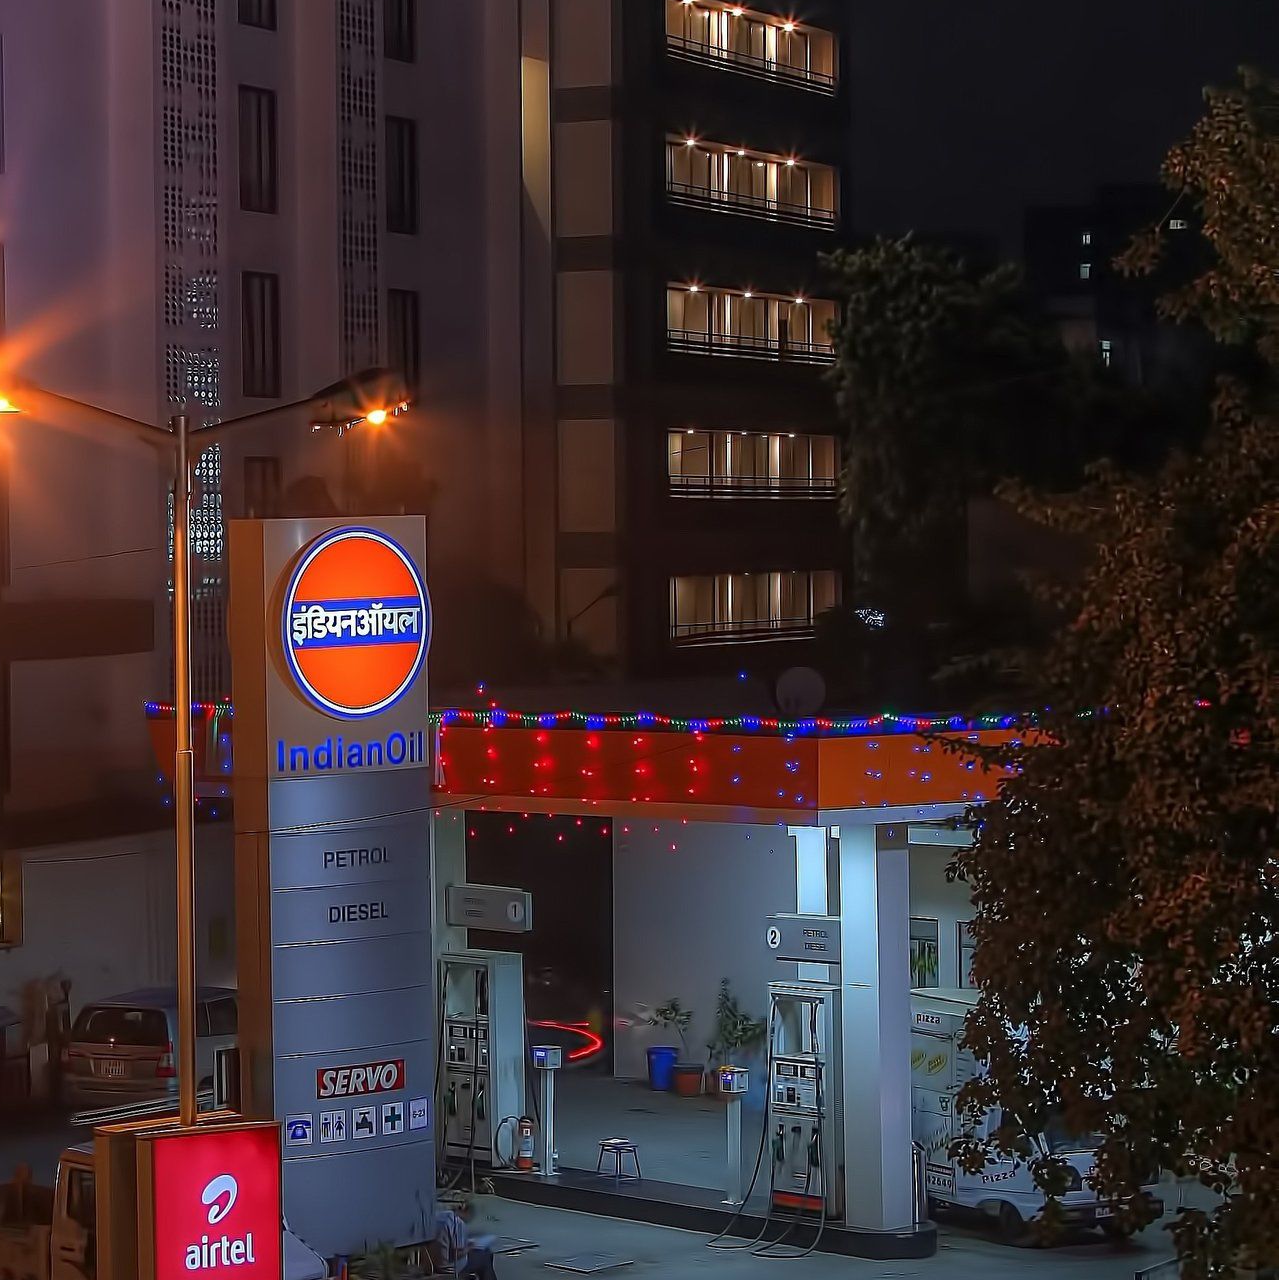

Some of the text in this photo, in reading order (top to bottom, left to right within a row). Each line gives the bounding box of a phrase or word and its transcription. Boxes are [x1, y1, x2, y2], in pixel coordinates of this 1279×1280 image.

[293, 603, 420, 646] इंडियनऑयल
[277, 731, 423, 772] IndianOil
[323, 846, 390, 869] PETROL
[328, 901, 388, 923] DIESEL
[770, 929, 777, 945] 2
[320, 1063, 398, 1097] SERVO
[185, 1233, 255, 1270] airtel
